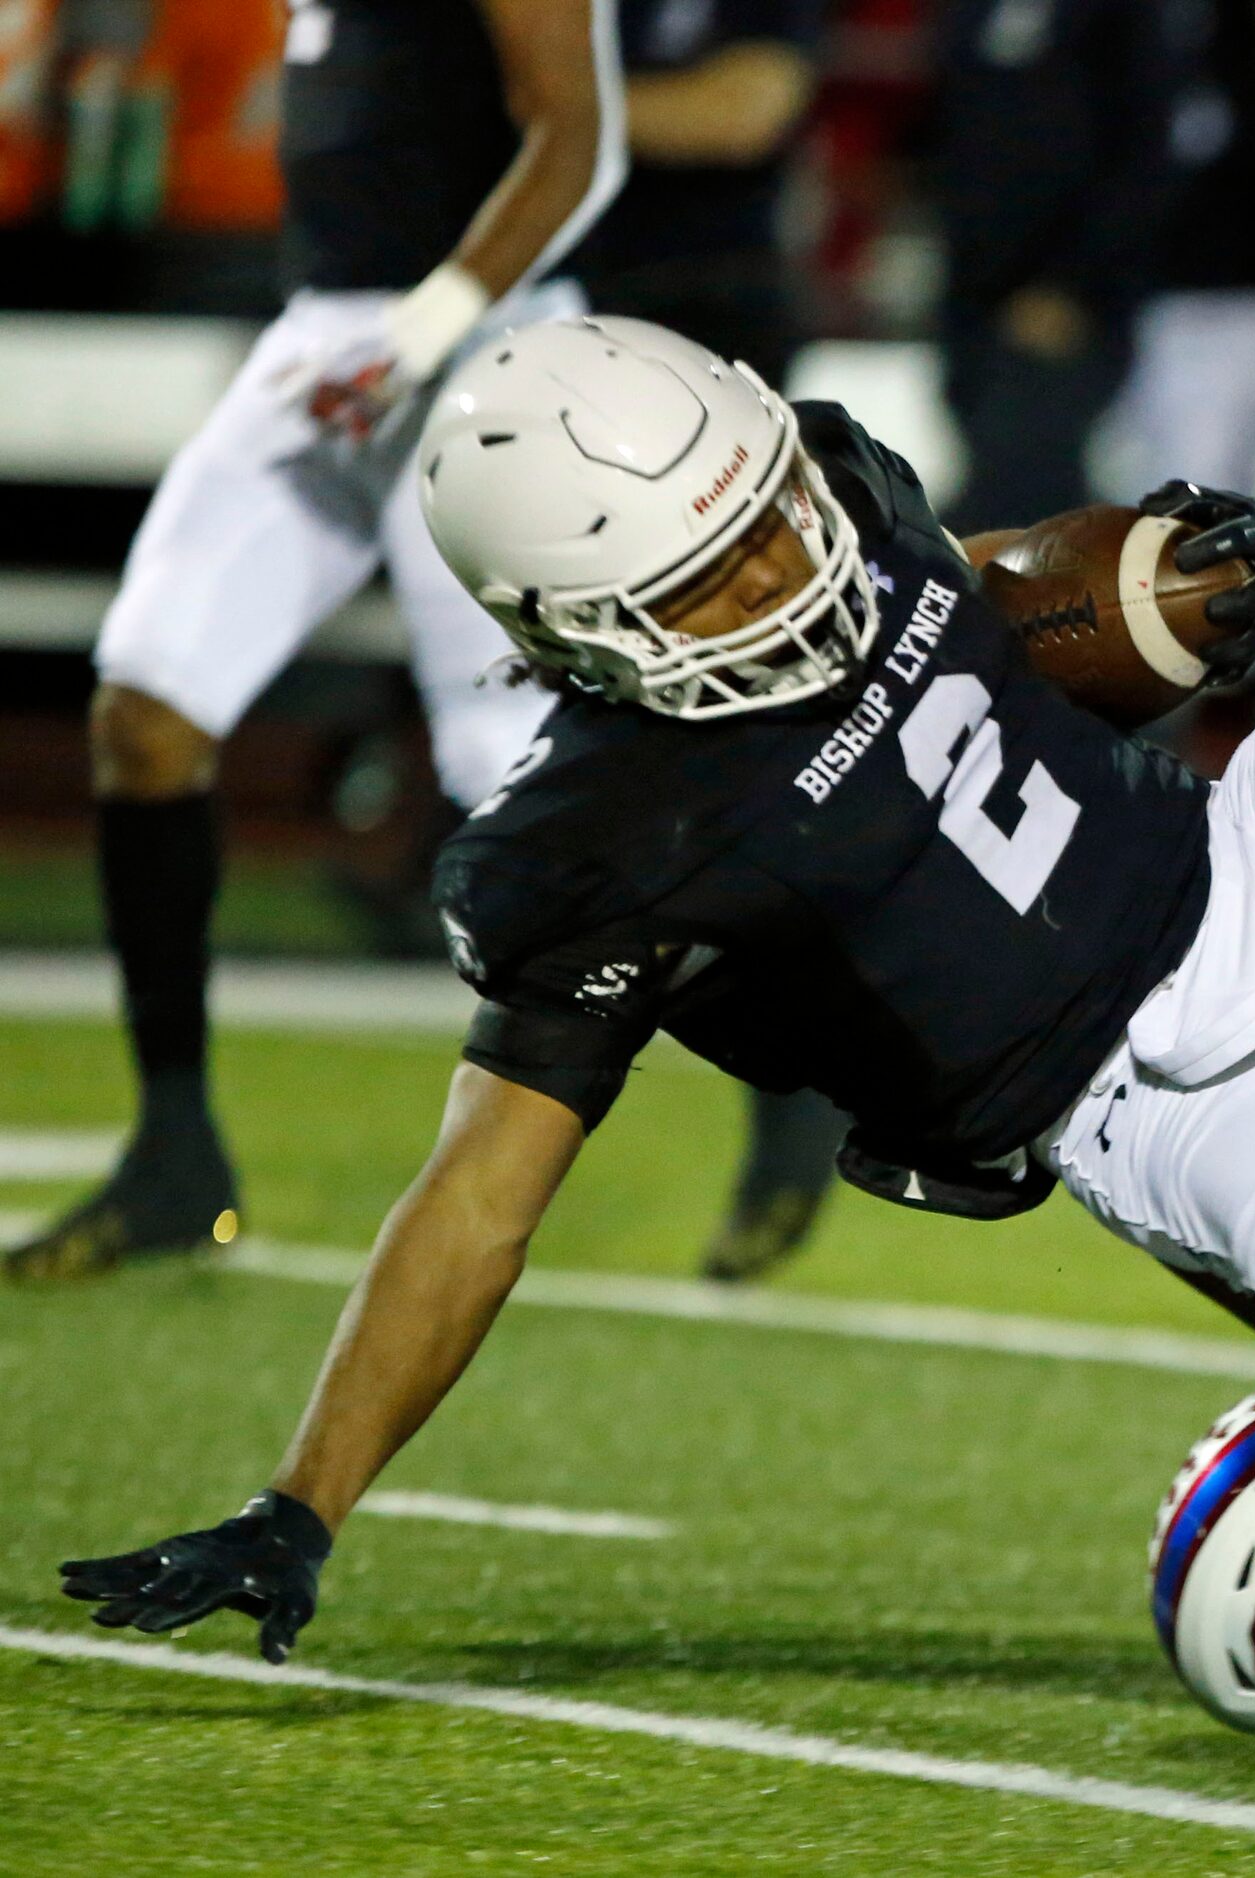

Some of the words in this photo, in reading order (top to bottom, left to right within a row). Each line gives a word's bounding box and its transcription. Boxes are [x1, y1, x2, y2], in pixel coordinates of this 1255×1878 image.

[693, 443, 749, 515] Riddell
[794, 682, 894, 804] BISHOP
[884, 578, 959, 685] LYNCH
[897, 673, 1083, 917] 2
